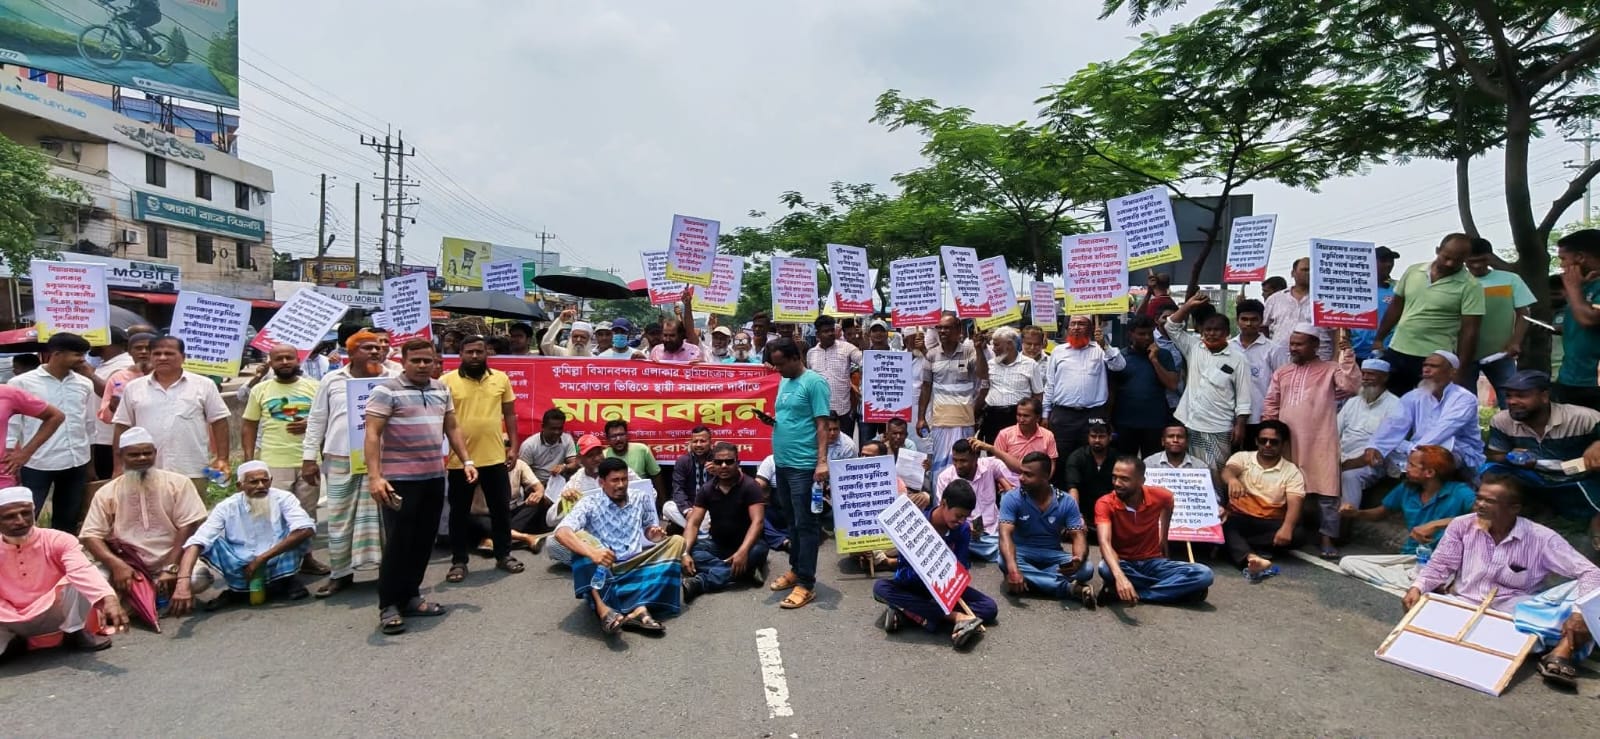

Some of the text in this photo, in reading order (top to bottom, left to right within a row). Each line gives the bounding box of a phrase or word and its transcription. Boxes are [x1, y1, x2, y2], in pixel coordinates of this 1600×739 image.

[43, 98, 87, 118] LEYLAND
[113, 267, 180, 282] MOBILE
[330, 294, 353, 302] AUTO
[354, 295, 384, 303] MOBILE
[552, 366, 582, 377] কুমিল্লা
[586, 365, 637, 376] বিমানবন্দর
[641, 367, 679, 377] এলাকার
[559, 381, 610, 392] সমঝোতার
[614, 379, 649, 392] ভিত্তিতে
[653, 380, 675, 393] স্থায়ী
[678, 382, 724, 392] সমাধানের
[551, 397, 767, 426] মানববন্ধন
